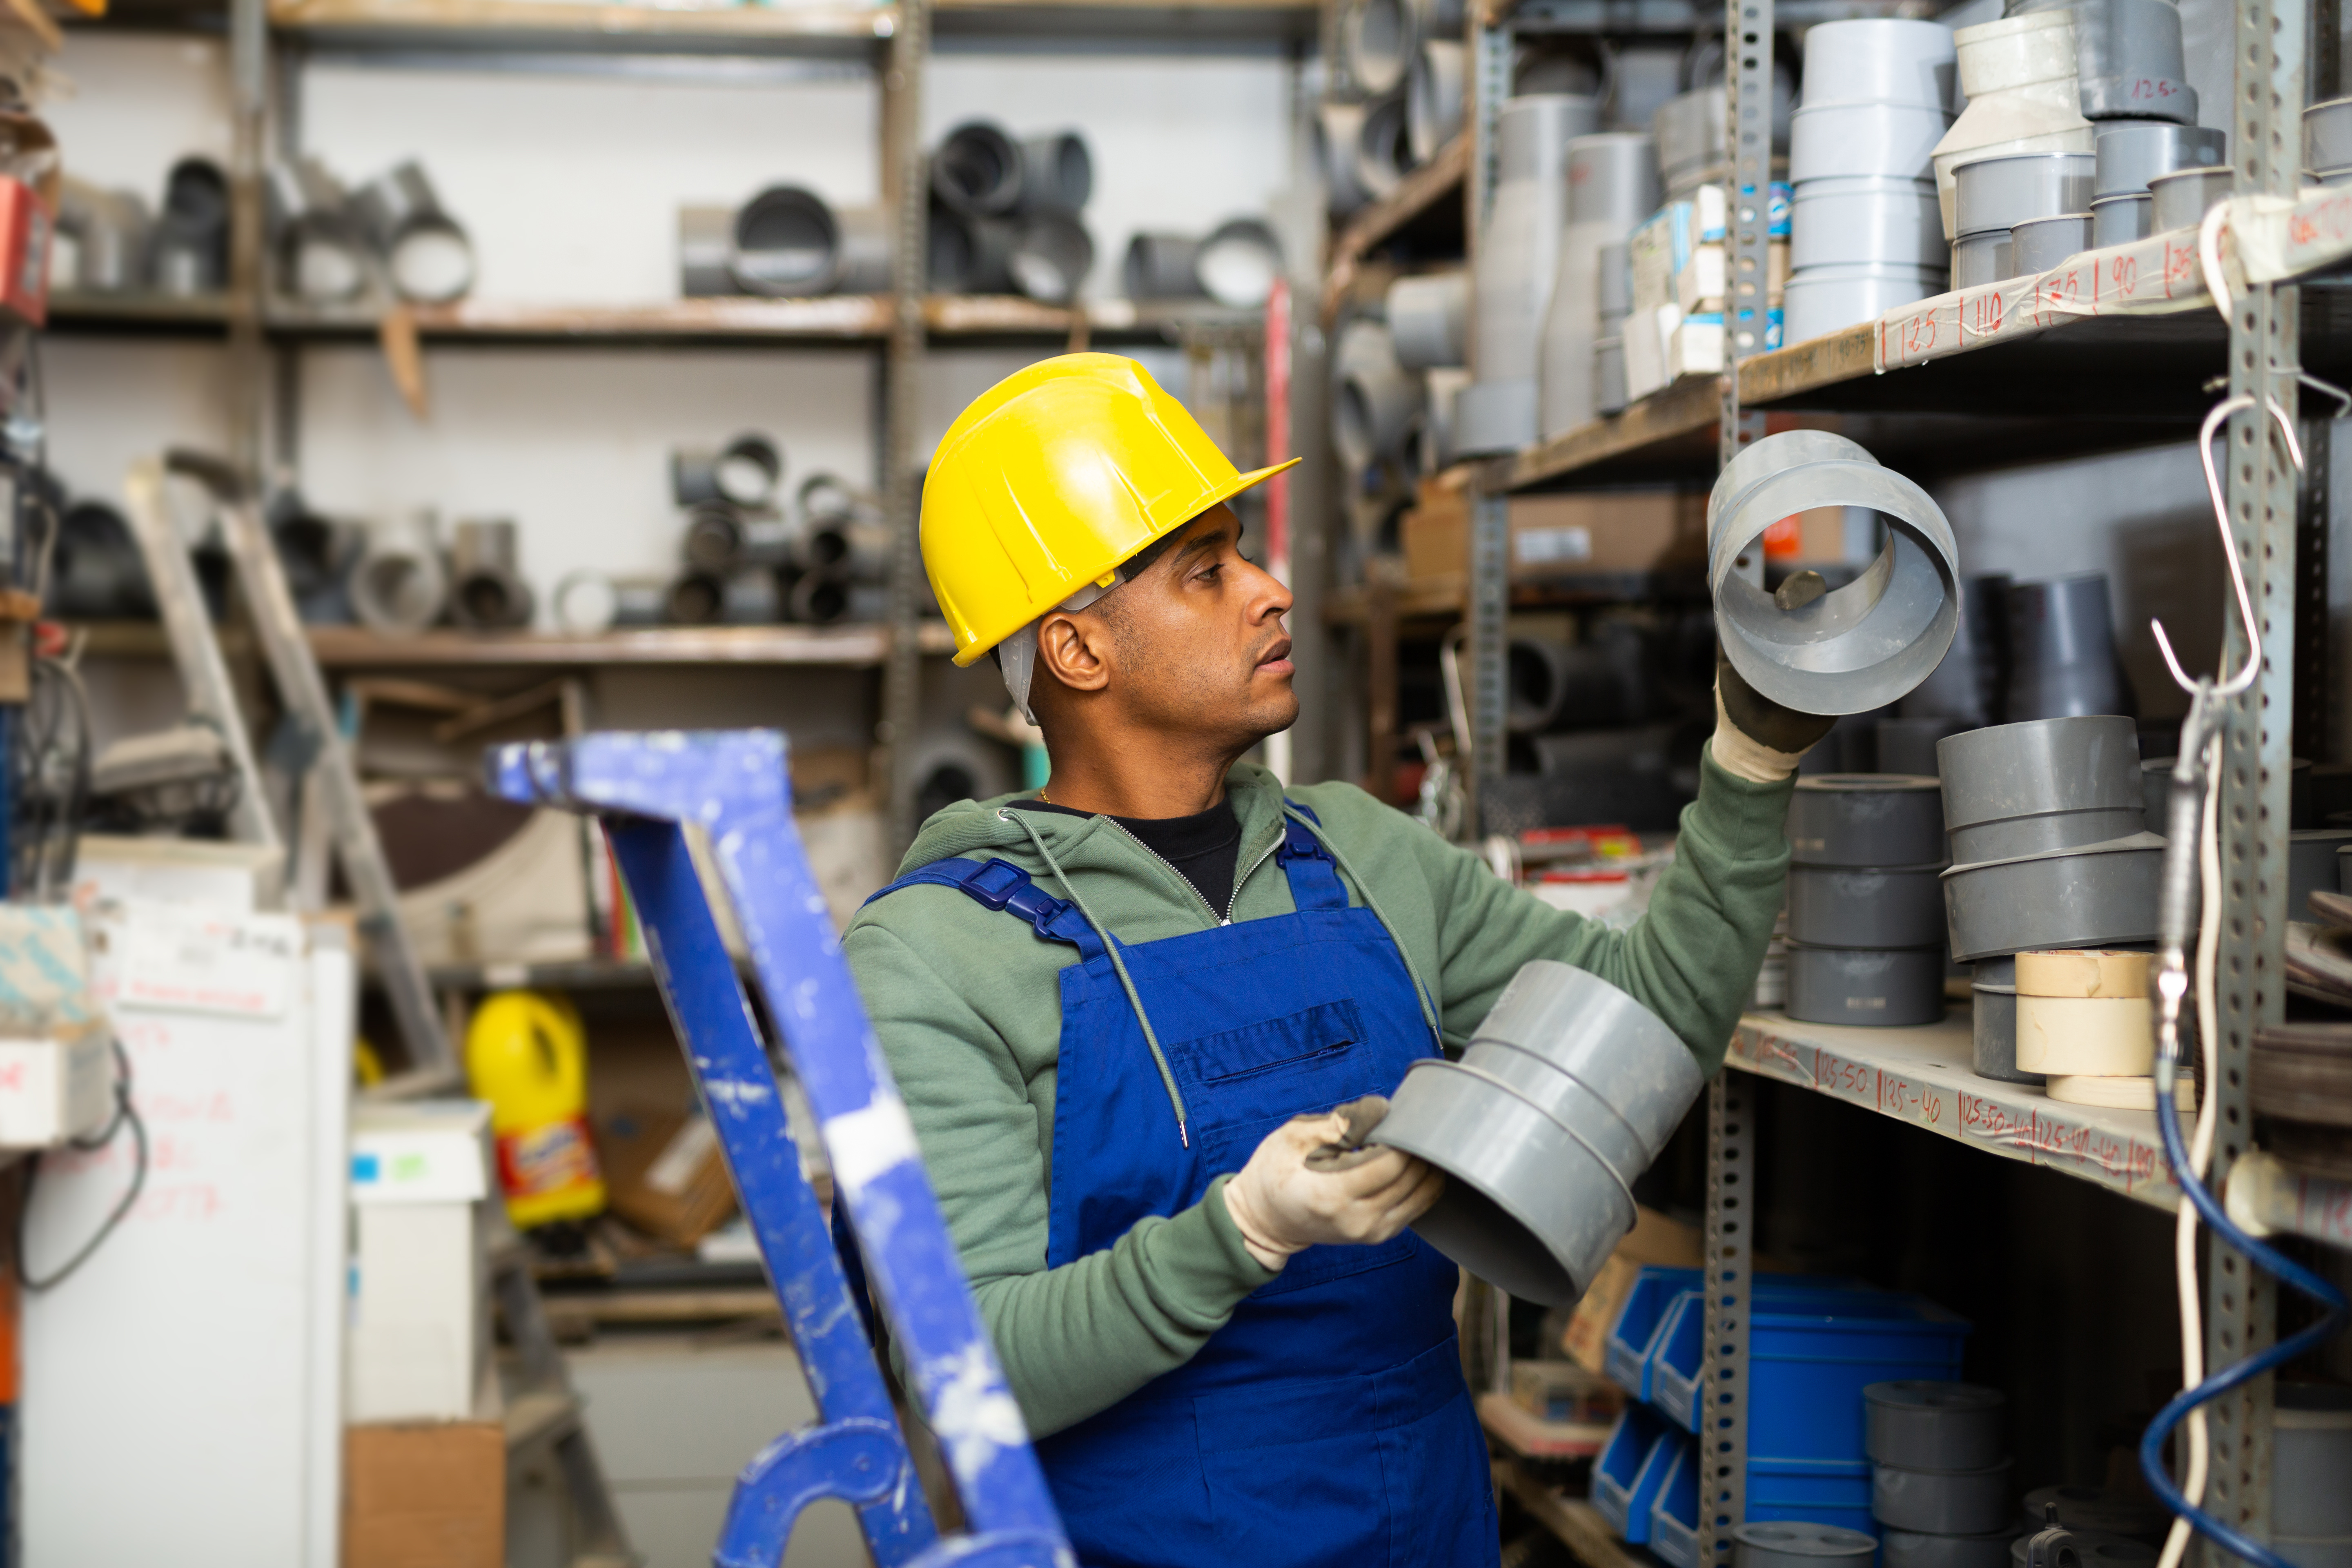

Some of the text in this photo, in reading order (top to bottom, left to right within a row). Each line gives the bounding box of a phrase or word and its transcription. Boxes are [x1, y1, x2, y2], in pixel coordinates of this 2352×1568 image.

[1902, 307, 1937, 361] 125
[1976, 292, 2002, 337] 110
[2112, 256, 2136, 299] 90
